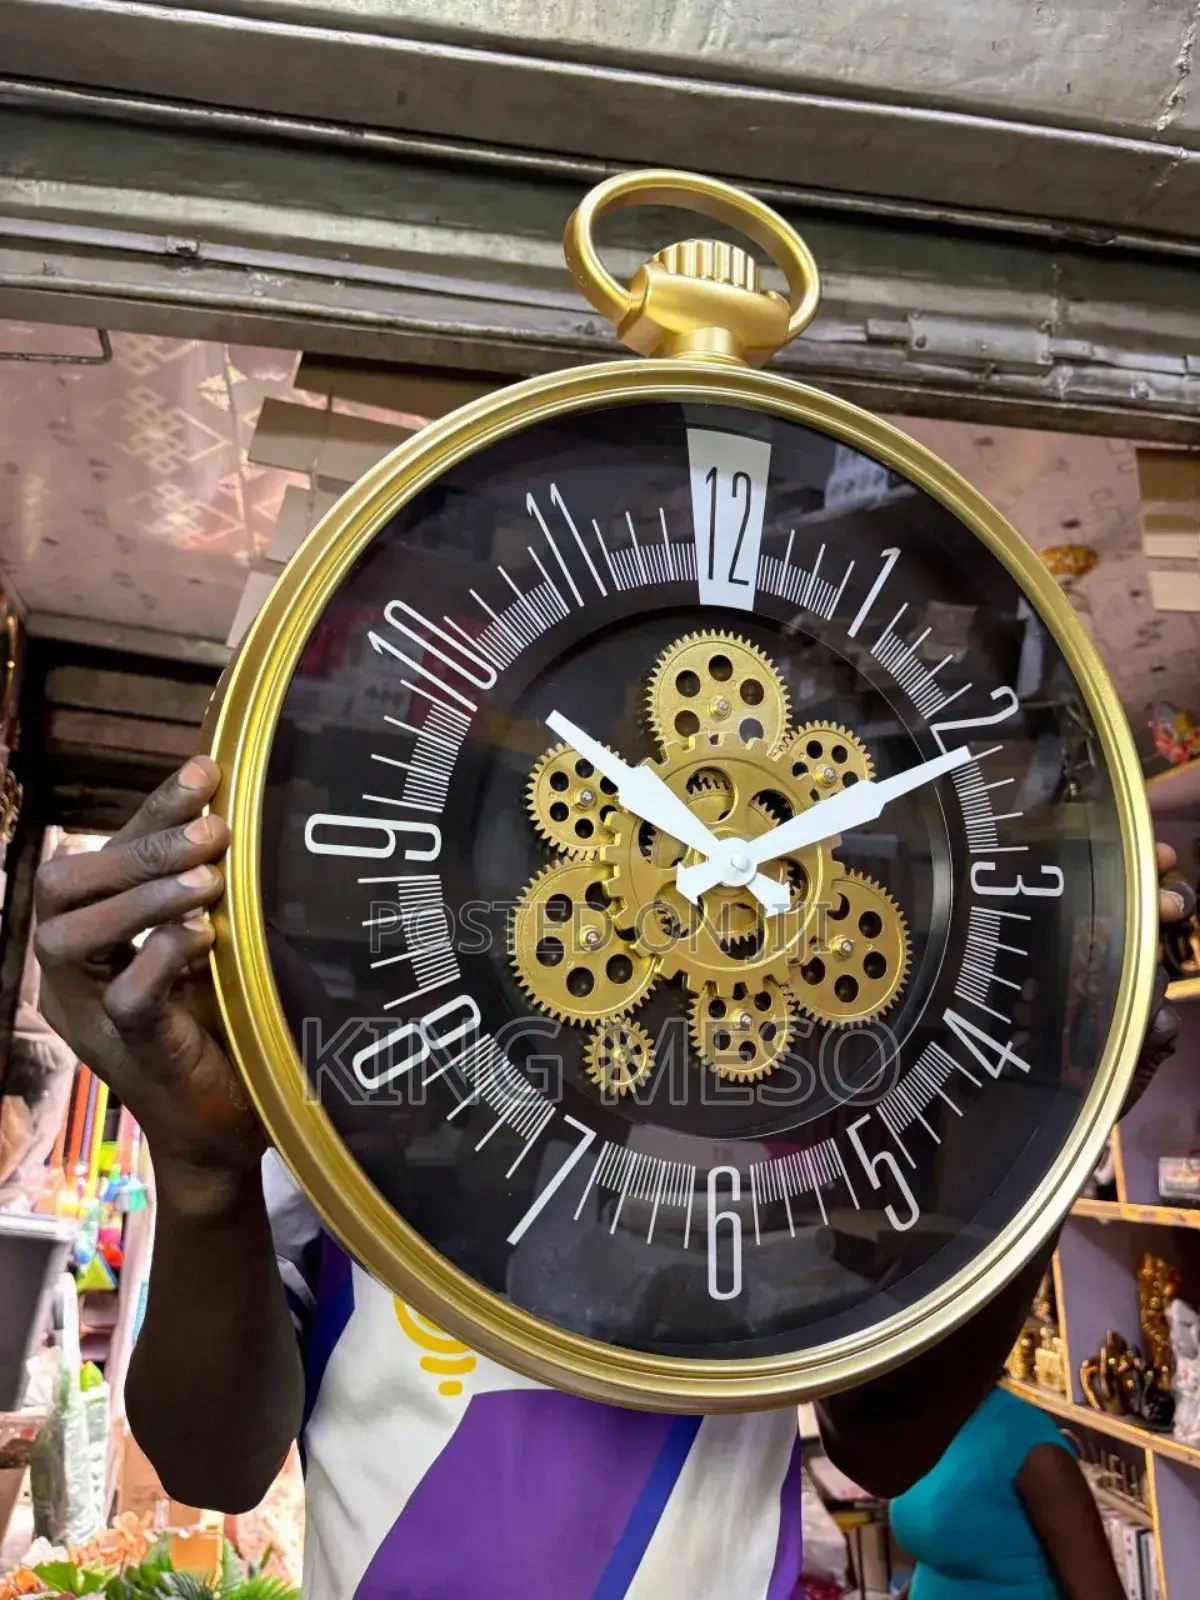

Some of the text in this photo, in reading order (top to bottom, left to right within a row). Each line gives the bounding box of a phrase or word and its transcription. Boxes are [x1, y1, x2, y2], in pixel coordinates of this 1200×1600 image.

[526, 482, 608, 607] 11
[706, 466, 752, 586] 12
[848, 546, 901, 638] 1
[367, 600, 498, 712] 10
[930, 685, 1019, 755] 2
[304, 813, 442, 861] 9
[970, 861, 1065, 897] 3
[352, 994, 481, 1090] 8
[942, 1007, 1031, 1080] 4
[506, 1114, 597, 1246] 7
[845, 1113, 920, 1232] 5
[707, 1165, 742, 1300] 6
